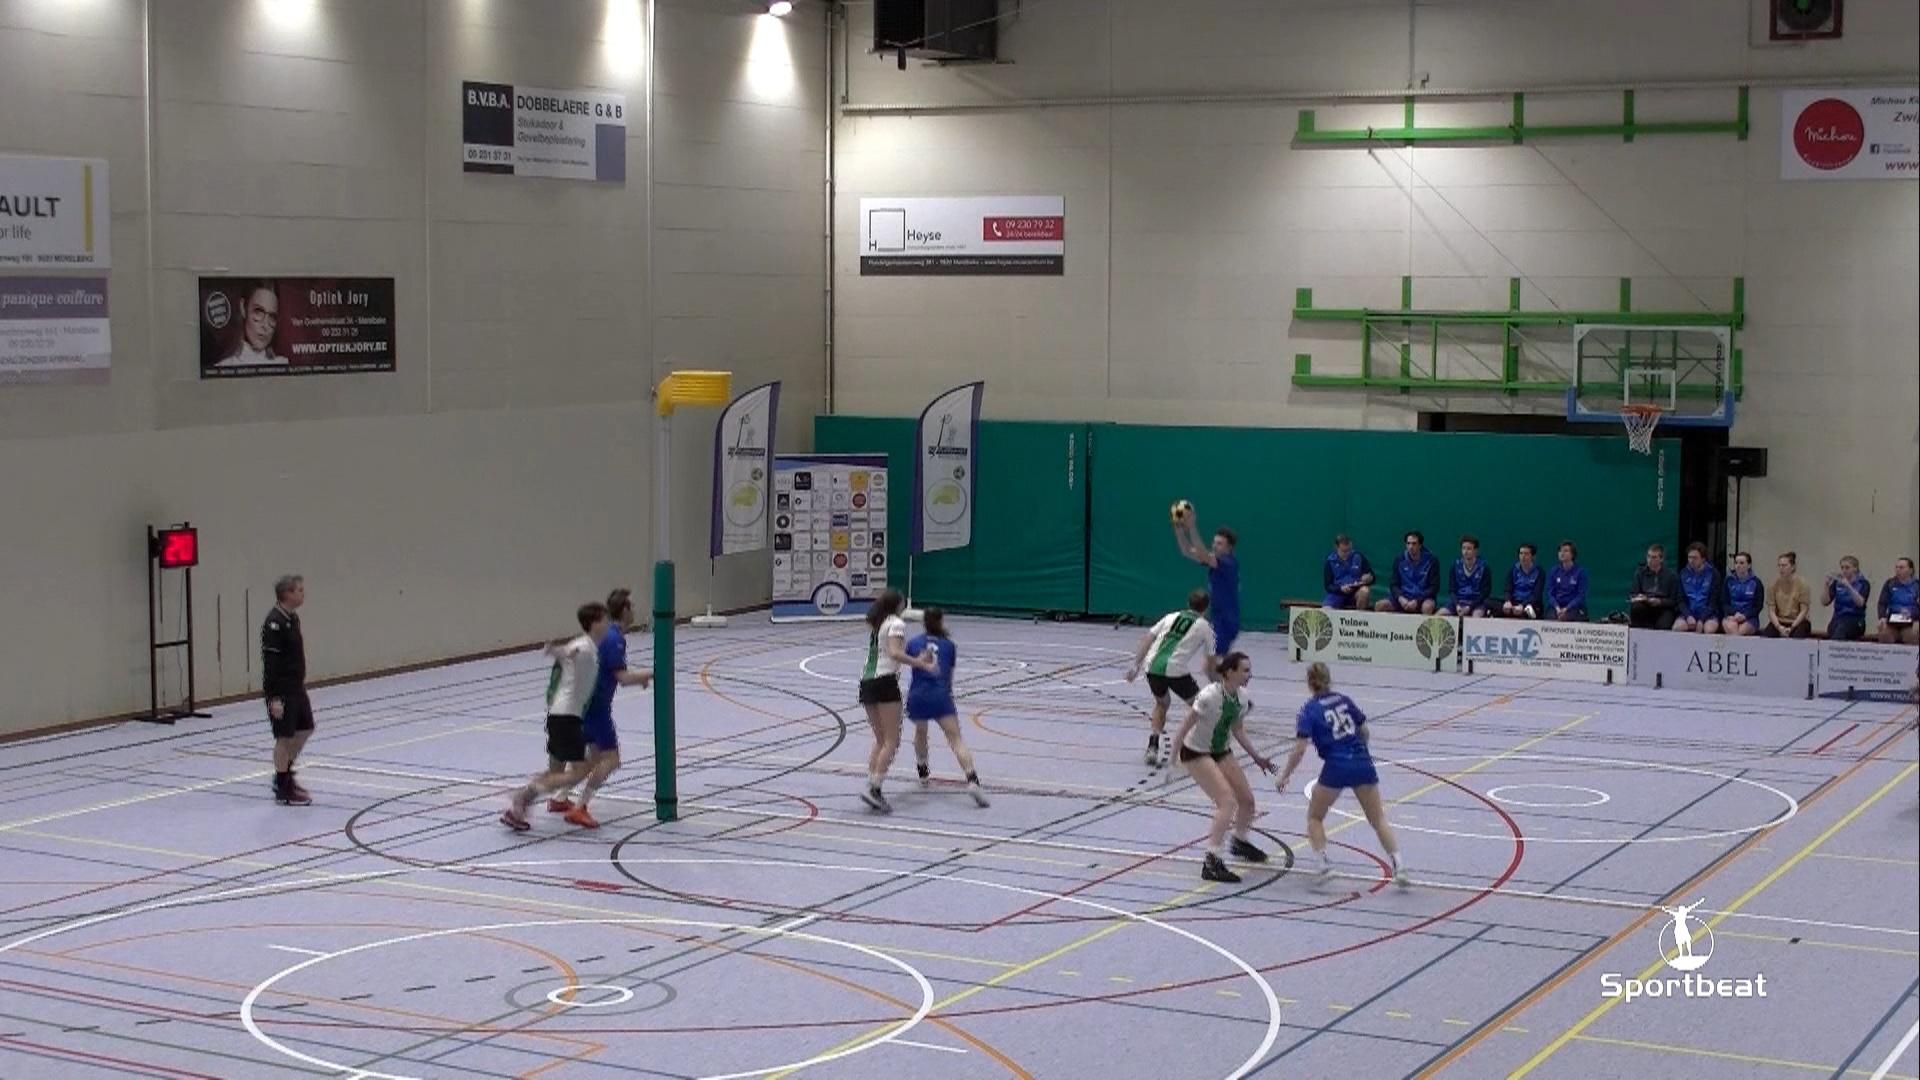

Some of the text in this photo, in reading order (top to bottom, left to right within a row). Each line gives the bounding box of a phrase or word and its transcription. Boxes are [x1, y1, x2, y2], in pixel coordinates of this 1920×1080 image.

[467, 89, 622, 118] B.V.B.A. DOBBELAERE G & B
[907, 229, 942, 244] Heyse
[2, 289, 105, 309] panique coiffure
[309, 289, 369, 308] Optiek Jory
[292, 341, 388, 355] WWW.OPTIEKJORY.BE
[1339, 617, 1369, 627] Tuinen
[1339, 628, 1354, 637] Van
[1356, 629, 1388, 639] Mullem
[1560, 651, 1624, 663] KENNETH TACK
[1686, 650, 1758, 677] ABEL
[1324, 703, 1356, 740] 25
